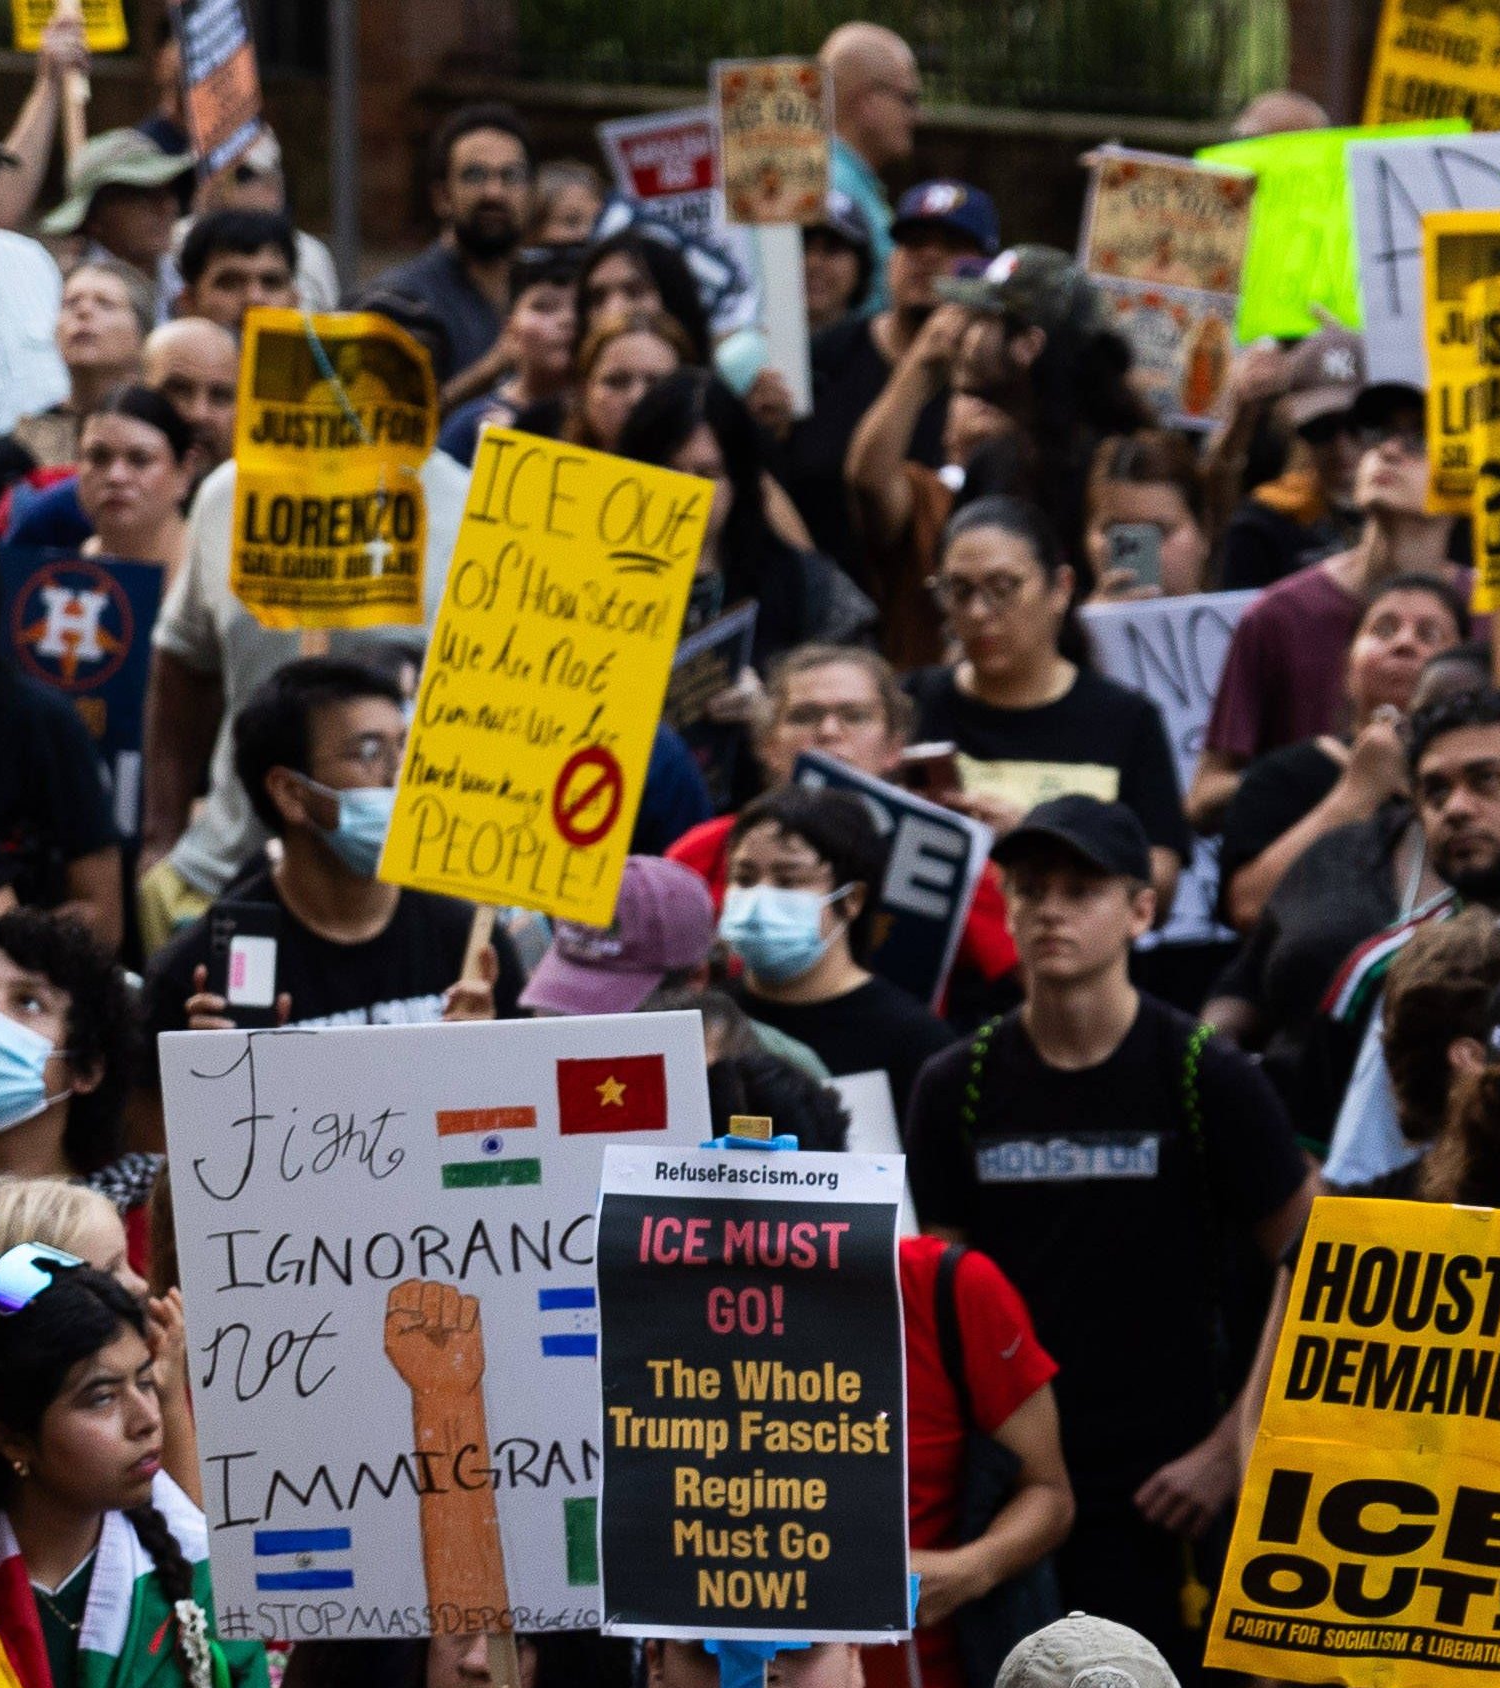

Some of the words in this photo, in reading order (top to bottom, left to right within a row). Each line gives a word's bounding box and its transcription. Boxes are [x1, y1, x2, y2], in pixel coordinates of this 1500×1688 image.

[468, 436, 588, 540] ICE
[243, 491, 420, 546] LORENZO
[190, 1031, 408, 1201] Fight
[654, 1161, 840, 1191] RefuseFascism.org
[206, 1213, 596, 1292] IGNORANC
[638, 1215, 712, 1265] ICE
[722, 1219, 851, 1270] MUST
[706, 1284, 786, 1337] GO!
[646, 1358, 722, 1401] The
[731, 1359, 862, 1404] Whole
[608, 1406, 730, 1460] Trump
[739, 1410, 891, 1455] Fascist
[205, 1436, 601, 1531] IMMIGRAN
[673, 1466, 828, 1518] Regime
[673, 1518, 769, 1559] Must
[777, 1521, 831, 1561] Go
[697, 1569, 808, 1611] NOW!
[1231, 1614, 1285, 1645] PARTY
[1287, 1621, 1321, 1648] FOR
[1323, 1627, 1410, 1654] SOCIALISM
[1410, 1633, 1425, 1654] &
